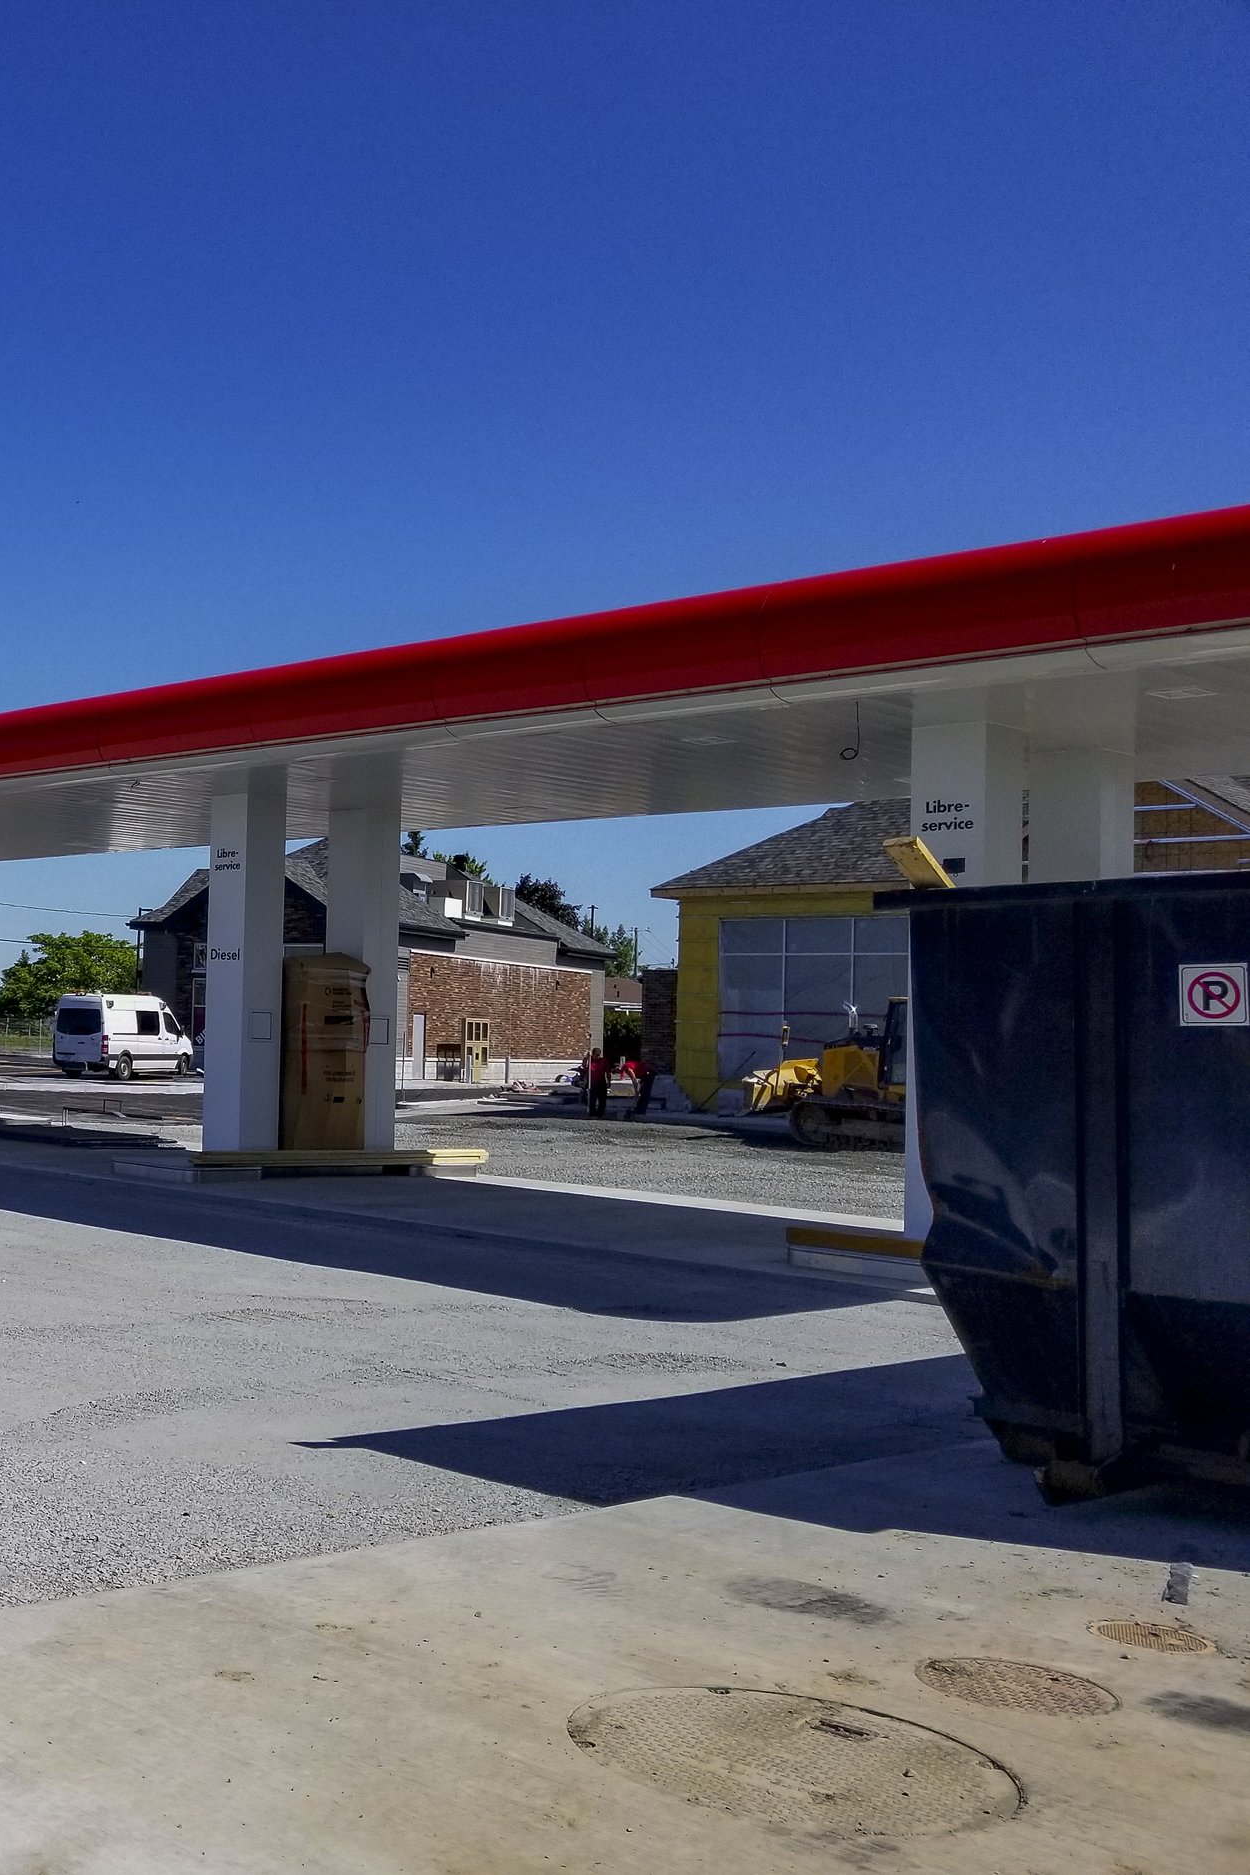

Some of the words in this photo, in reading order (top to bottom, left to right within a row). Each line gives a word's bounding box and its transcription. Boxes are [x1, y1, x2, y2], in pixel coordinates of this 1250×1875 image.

[926, 799, 970, 814] Libre-
[921, 816, 974, 832] service
[217, 848, 239, 859] Libre-
[214, 861, 241, 871] service
[210, 948, 241, 961] Diesel
[1202, 980, 1229, 1011] P
